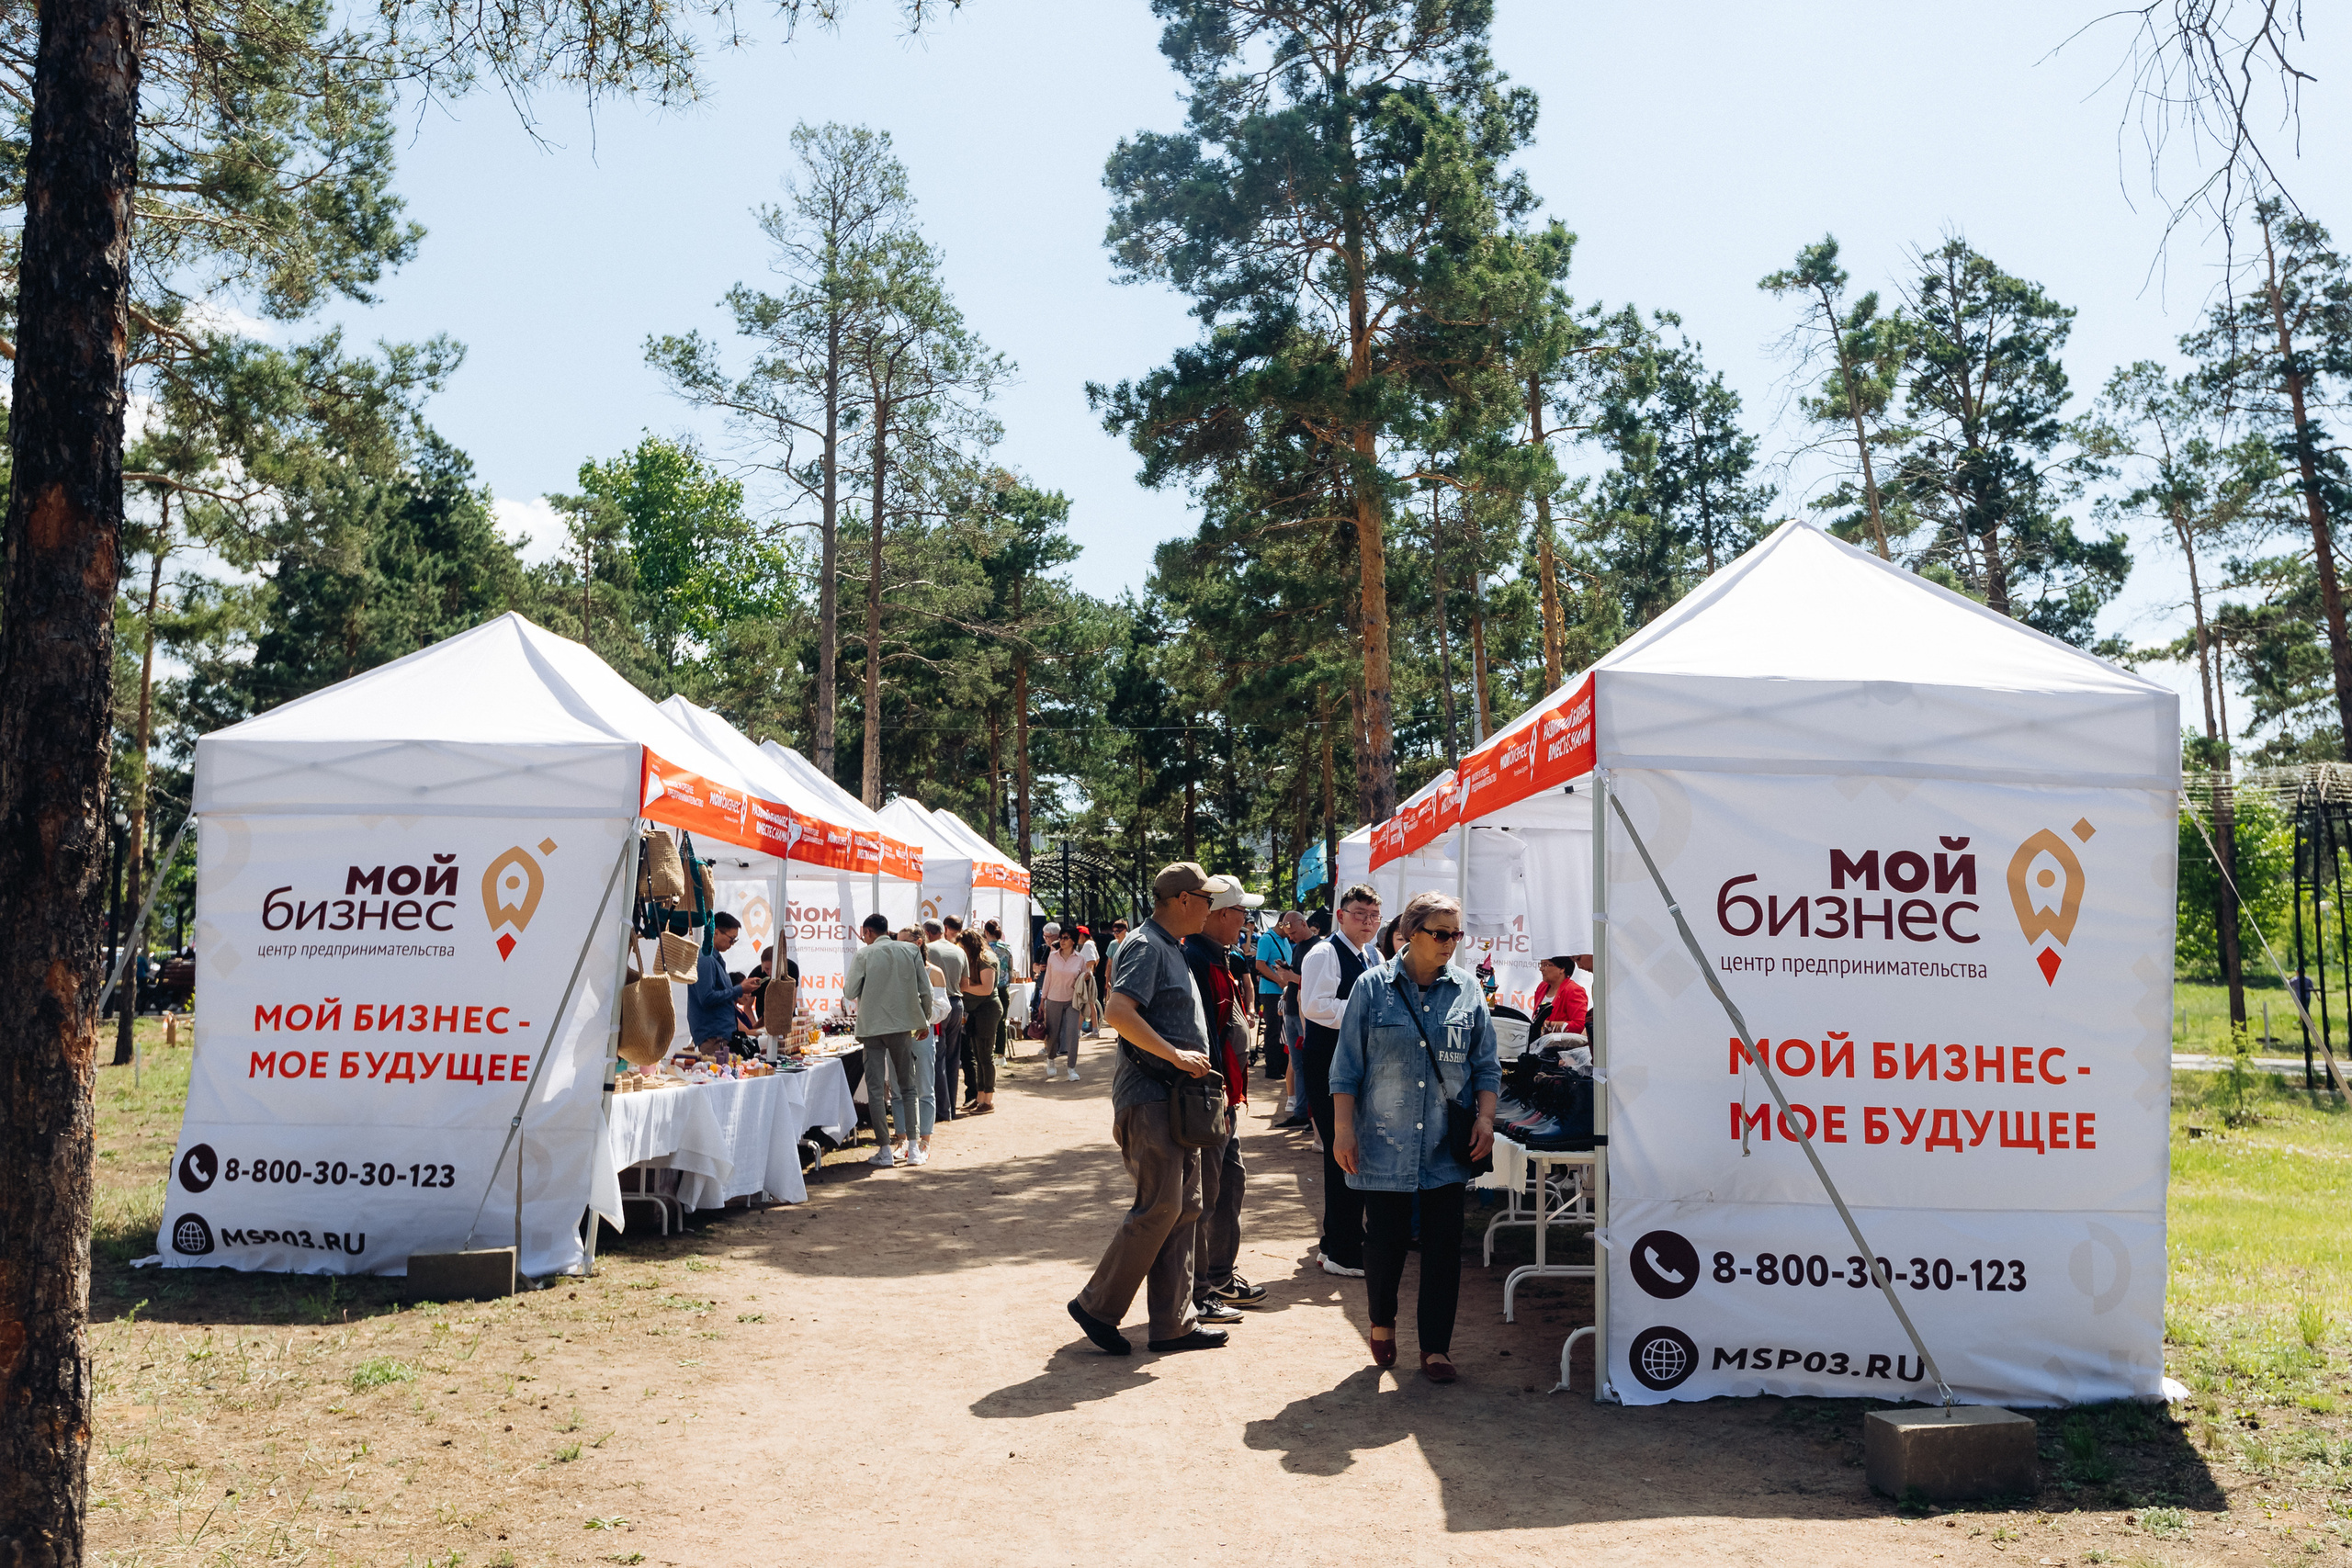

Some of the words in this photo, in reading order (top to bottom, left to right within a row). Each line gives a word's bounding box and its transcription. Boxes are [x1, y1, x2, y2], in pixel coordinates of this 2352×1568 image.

[262, 885, 457, 931] бизнес
[1716, 873, 1981, 944] бизнес
[257, 944, 297, 960] центр
[301, 943, 455, 960] предпринимательства
[1721, 955, 1776, 976] центр
[1781, 956, 1987, 980] предпринимательства
[254, 997, 342, 1032] МОЙ
[248, 1051, 329, 1079] МОЕ
[339, 1051, 530, 1086] БУДУЩЕЕ
[1729, 1031, 1855, 1078] МОЙ
[1730, 1102, 1848, 1144] МОЕ
[1863, 1106, 2097, 1155] БУДУЩЕЕ
[224, 1157, 456, 1189] 8-800-30-30-123
[1712, 1250, 2027, 1292] 8-800-30-30-123
[1711, 1347, 1926, 1382] MSP03.RU
